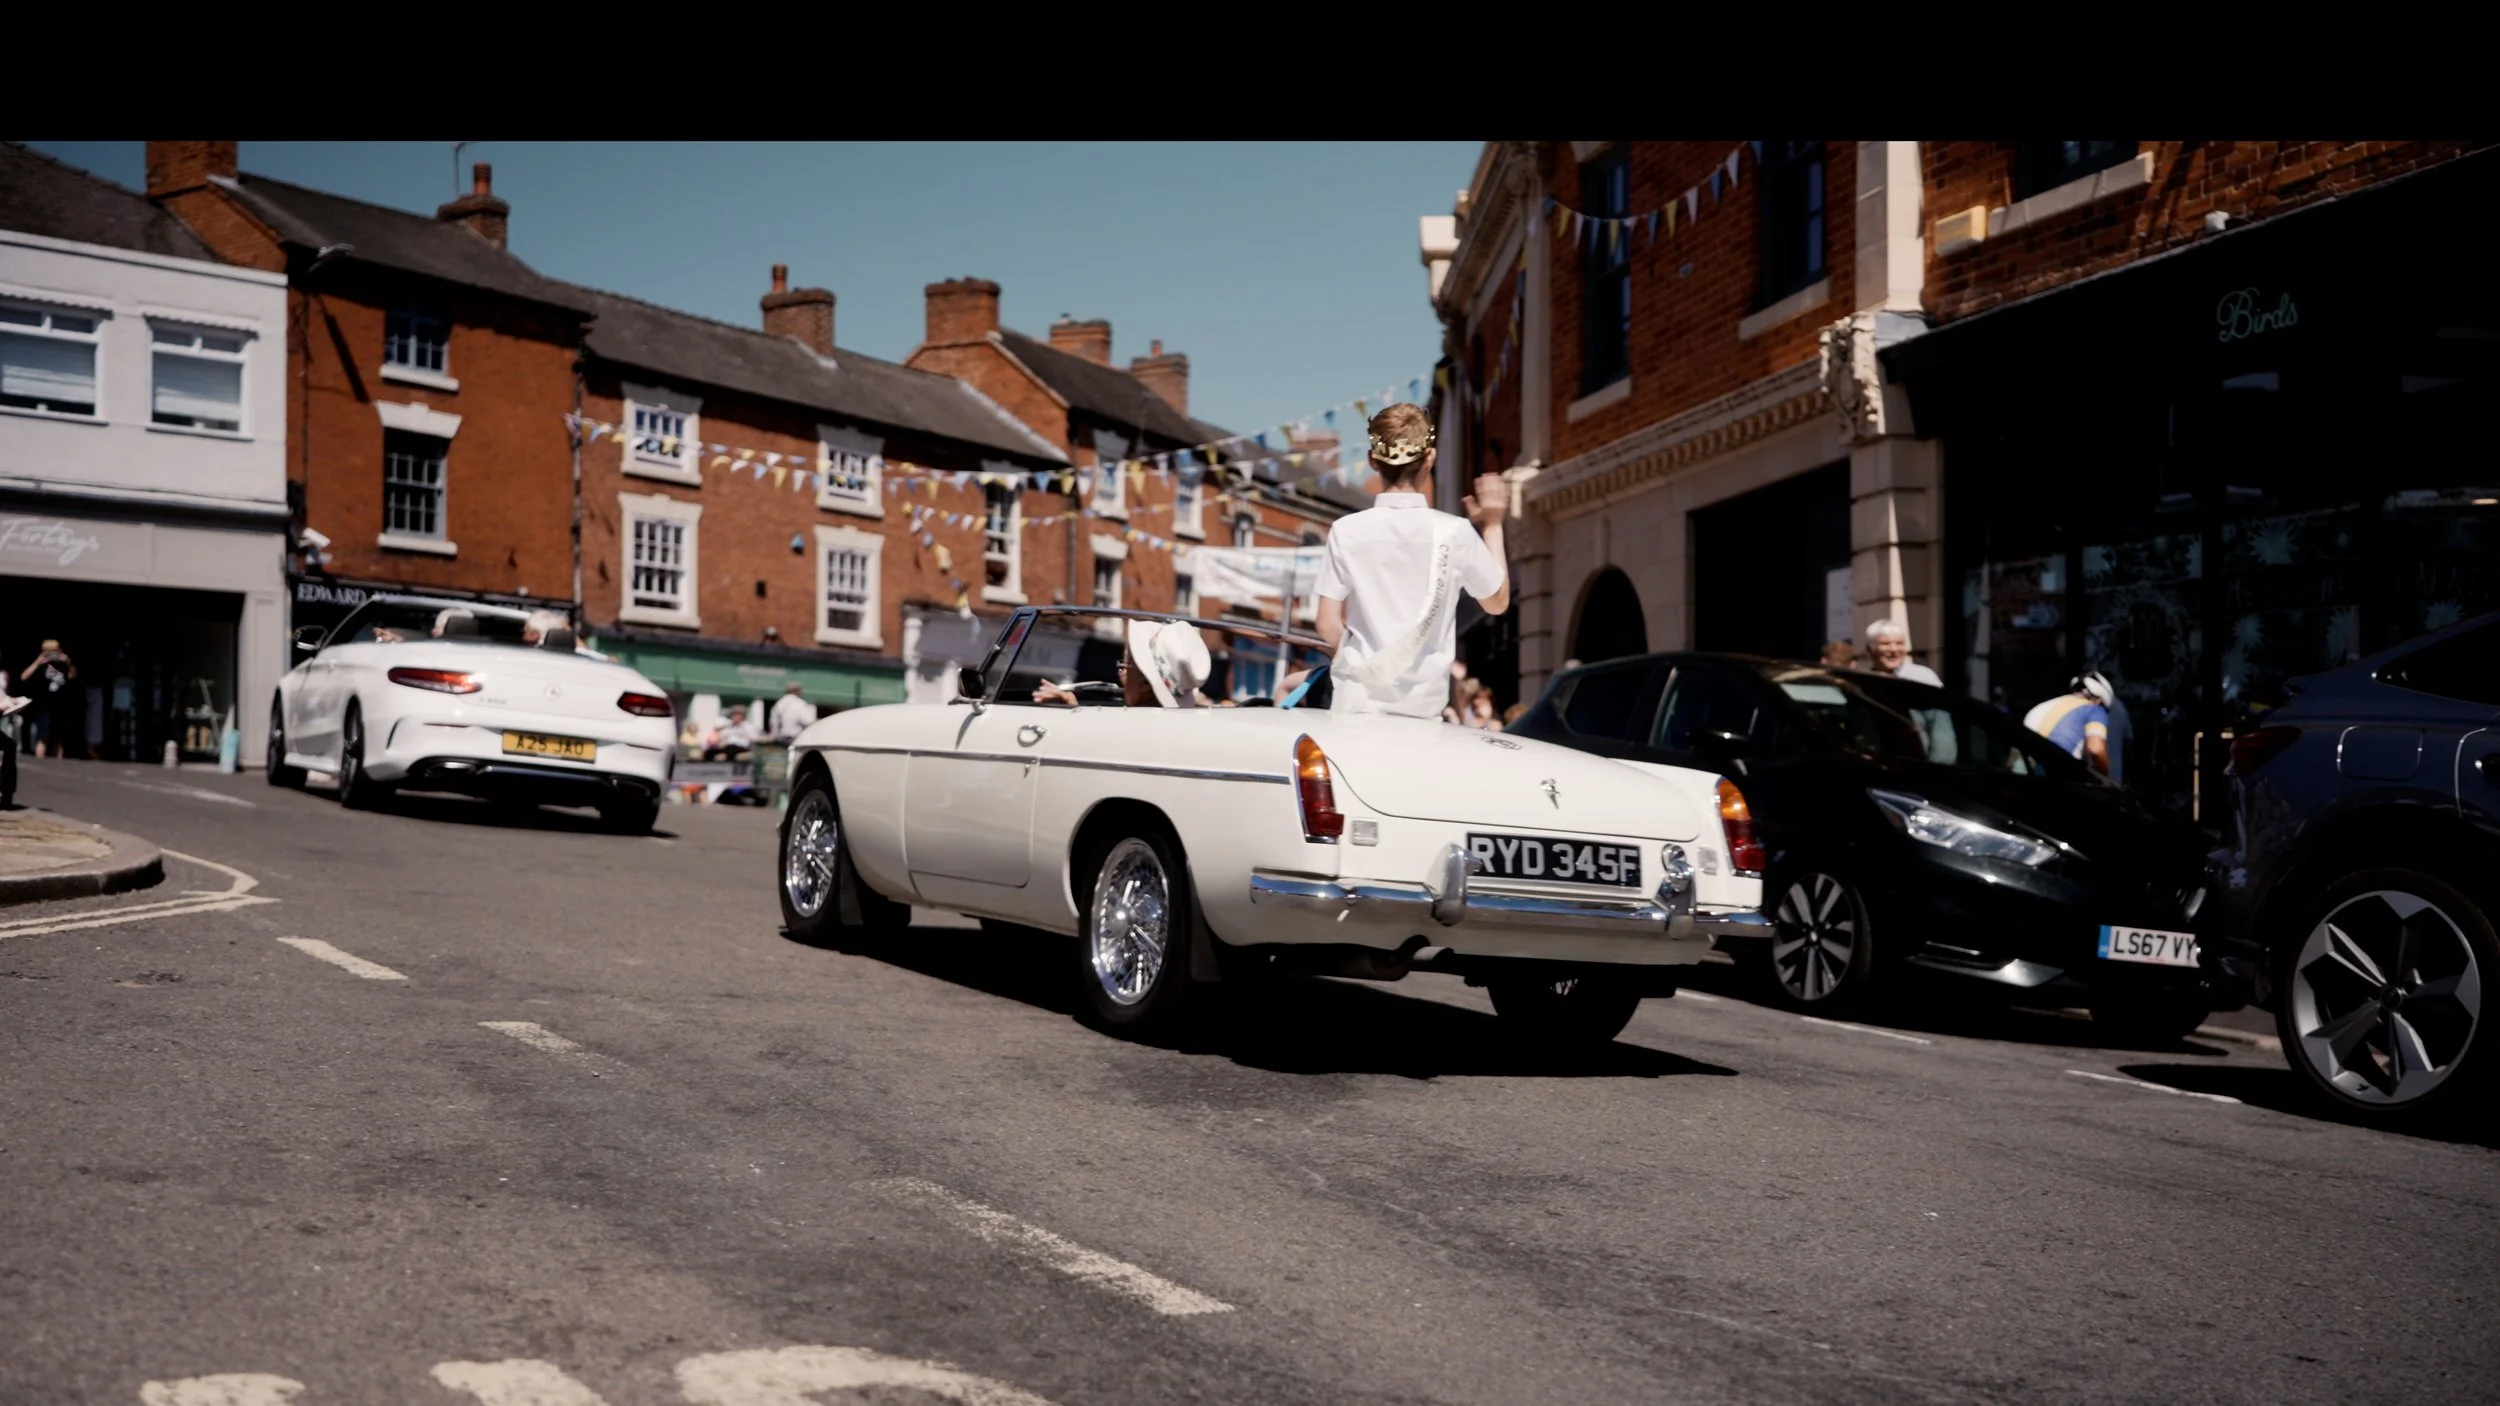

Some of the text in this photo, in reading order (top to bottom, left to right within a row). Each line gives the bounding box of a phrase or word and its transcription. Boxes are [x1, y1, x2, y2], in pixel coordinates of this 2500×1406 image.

[2217, 287, 2298, 342] Birds
[297, 583, 367, 606] EDWARD
[516, 734, 547, 752] A25
[1471, 837, 1638, 883] RYD 345F
[2113, 930, 2196, 962] LS67 VY
